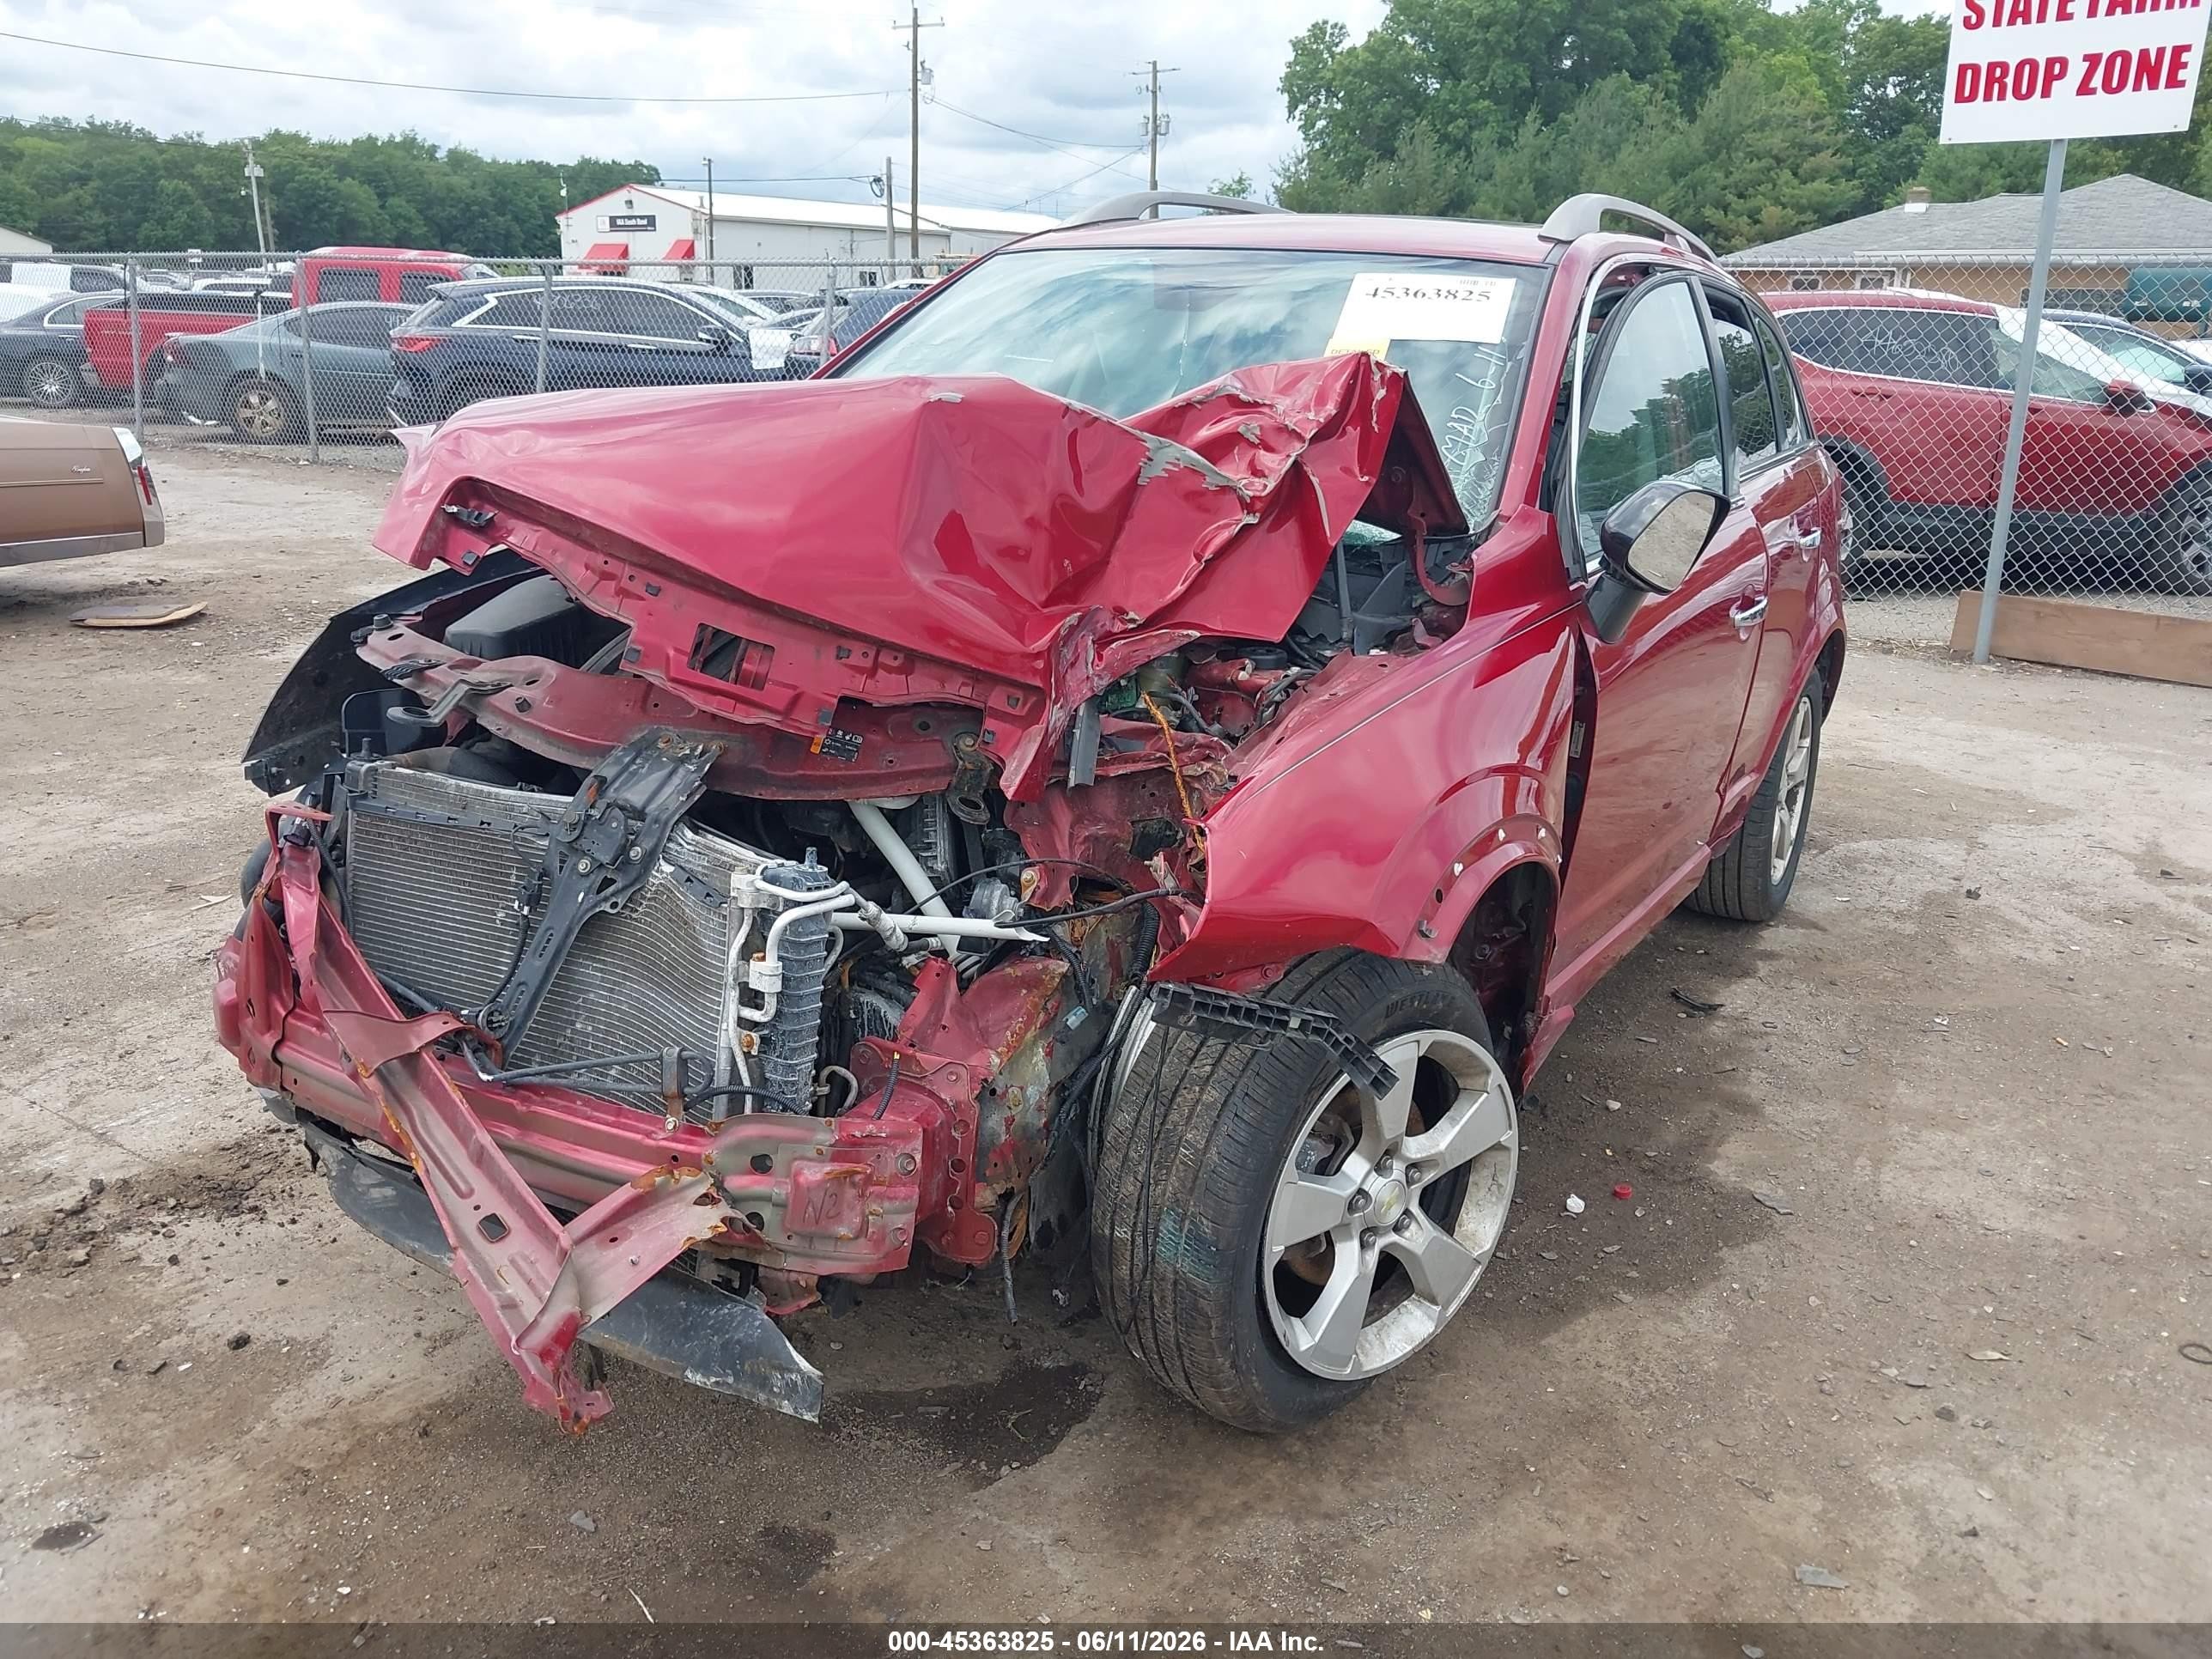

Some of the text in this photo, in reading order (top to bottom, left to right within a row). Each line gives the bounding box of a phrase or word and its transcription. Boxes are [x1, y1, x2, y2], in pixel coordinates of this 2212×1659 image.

[1954, 44, 2192, 104] DROP ZONE
[1365, 286, 1492, 302] 45363825
